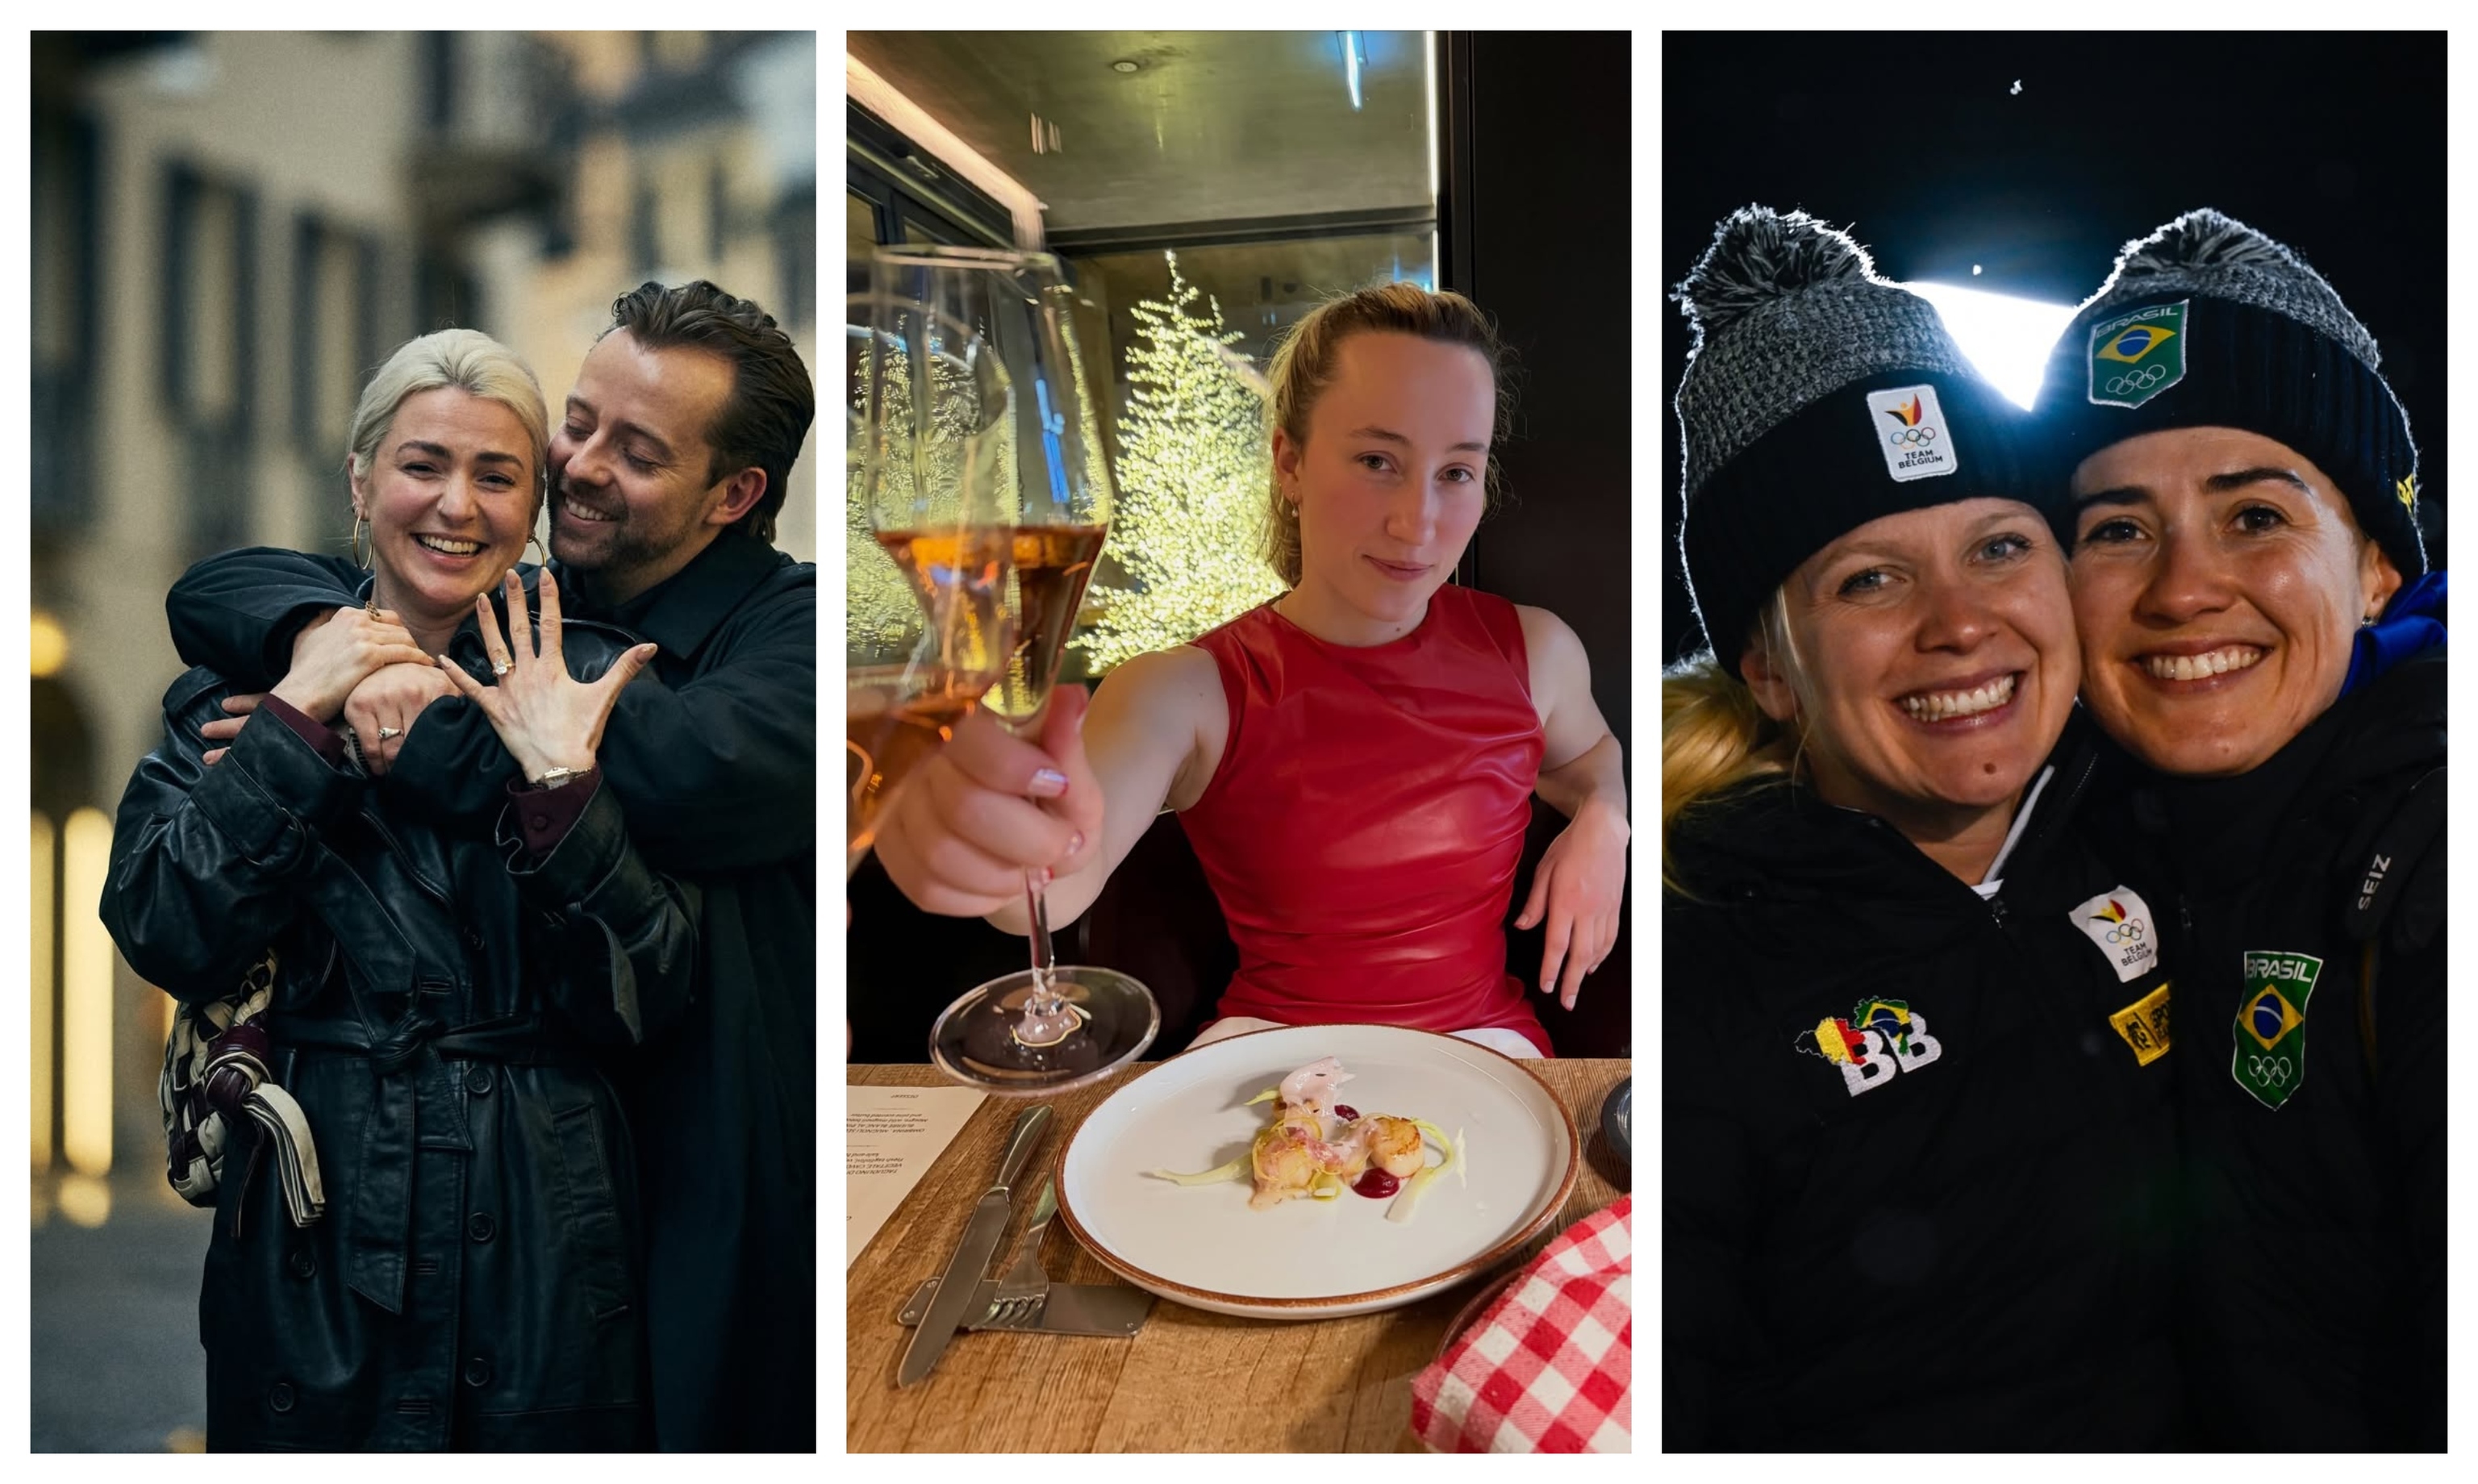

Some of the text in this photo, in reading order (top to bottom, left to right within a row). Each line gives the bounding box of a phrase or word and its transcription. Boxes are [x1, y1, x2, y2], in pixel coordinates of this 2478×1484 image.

[2096, 306, 2178, 339] BRASIL
[1898, 455, 1943, 469] BELGIUM
[1904, 449, 1934, 460] TEAM
[2358, 853, 2391, 910] SEIZ
[2121, 948, 2152, 966] BELGIUM
[2123, 941, 2147, 956] TEAM
[2246, 958, 2312, 982] BRASIL
